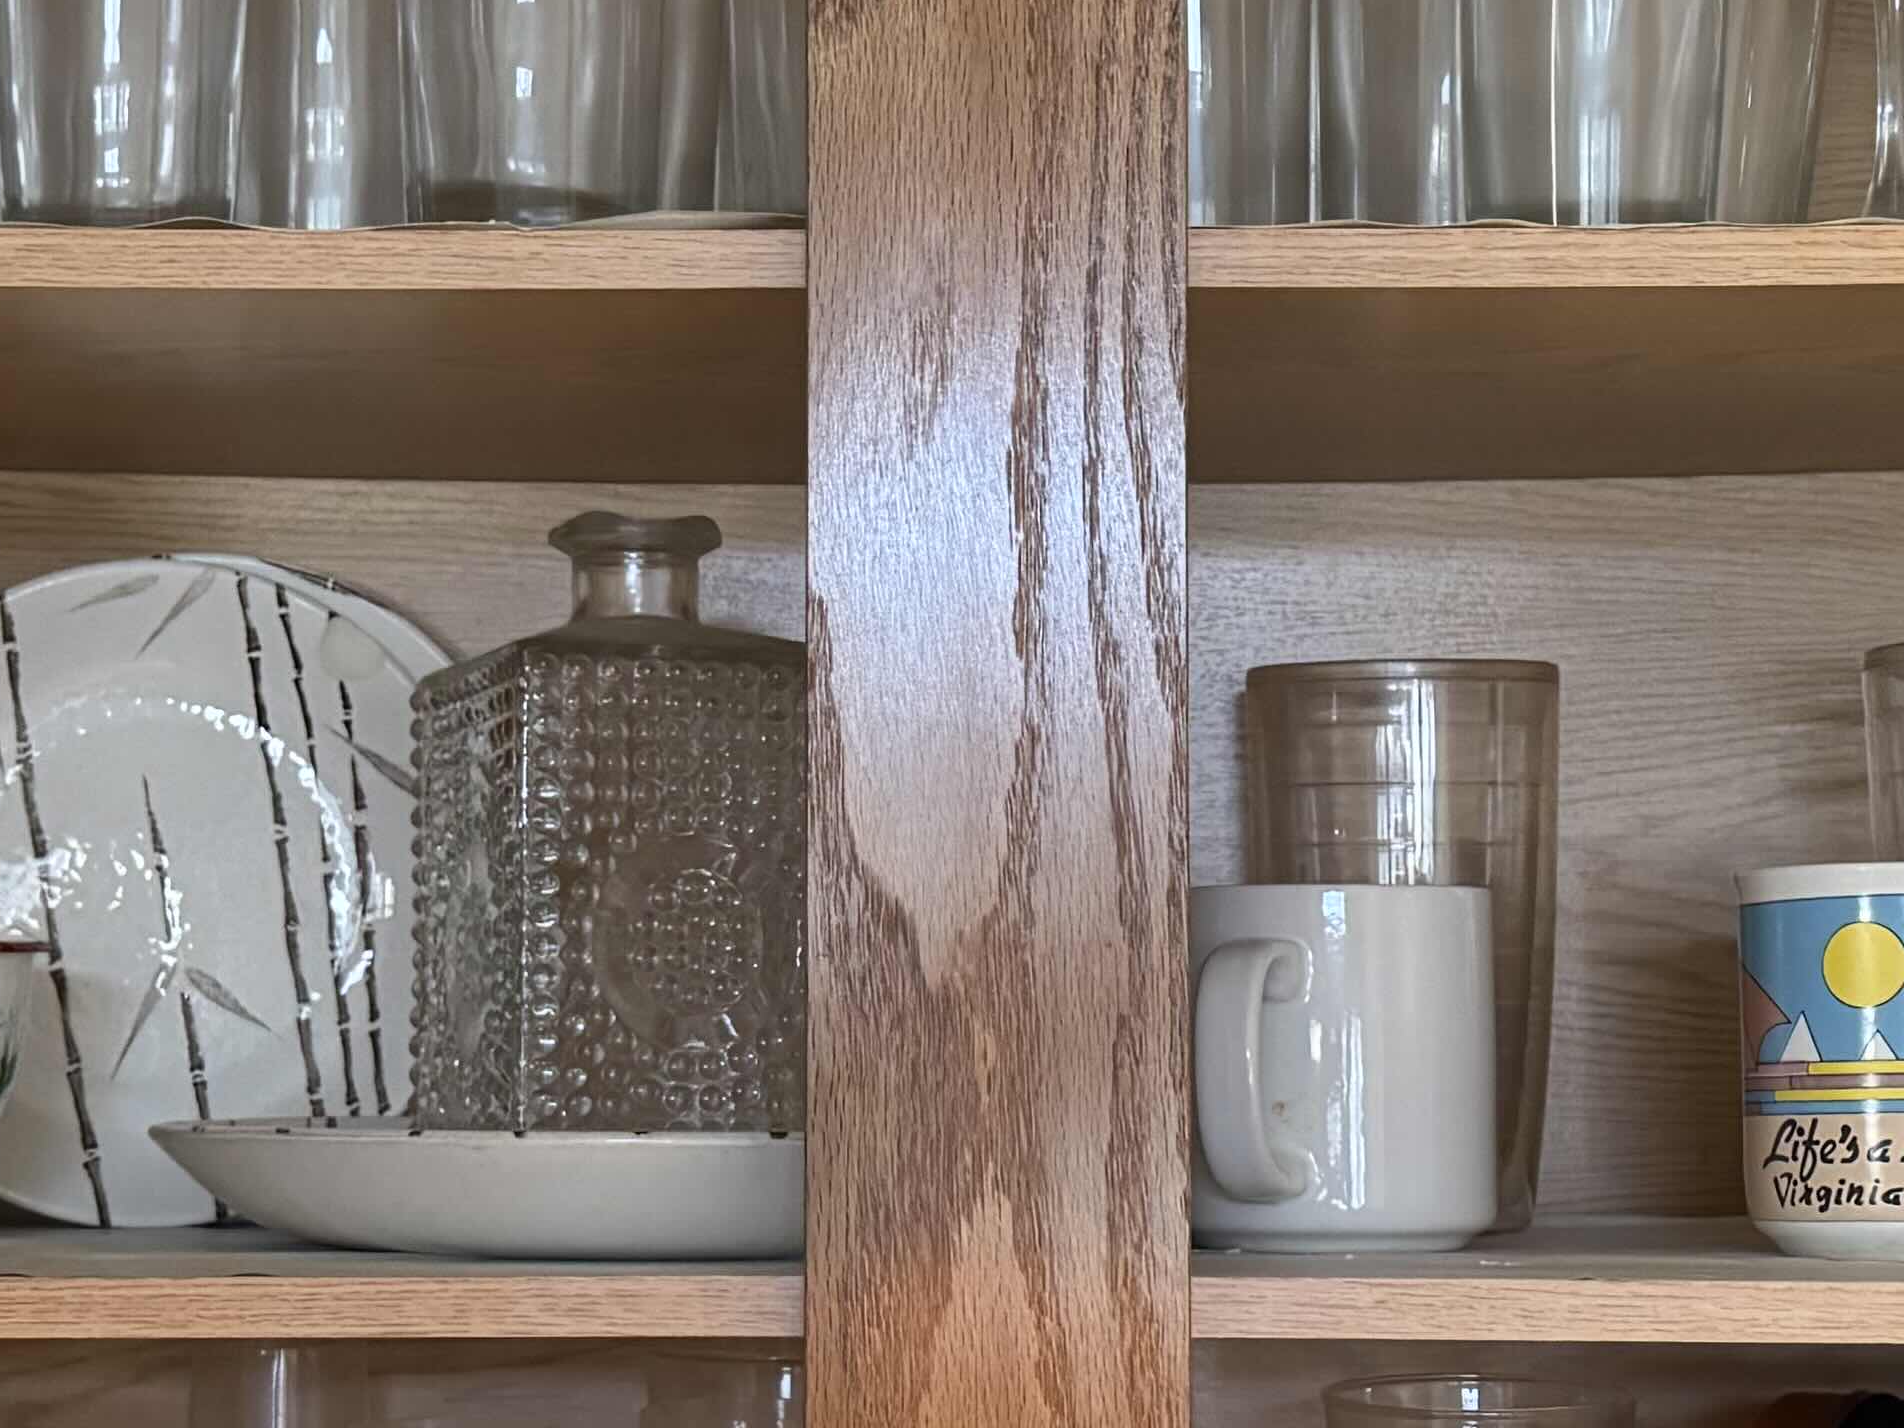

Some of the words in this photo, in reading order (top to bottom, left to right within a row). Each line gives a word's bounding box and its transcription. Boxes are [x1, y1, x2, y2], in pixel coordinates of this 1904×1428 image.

[1763, 1117, 1860, 1183] Life's
[1866, 1138, 1893, 1163] a
[1773, 1172, 1904, 1213] Virginia
